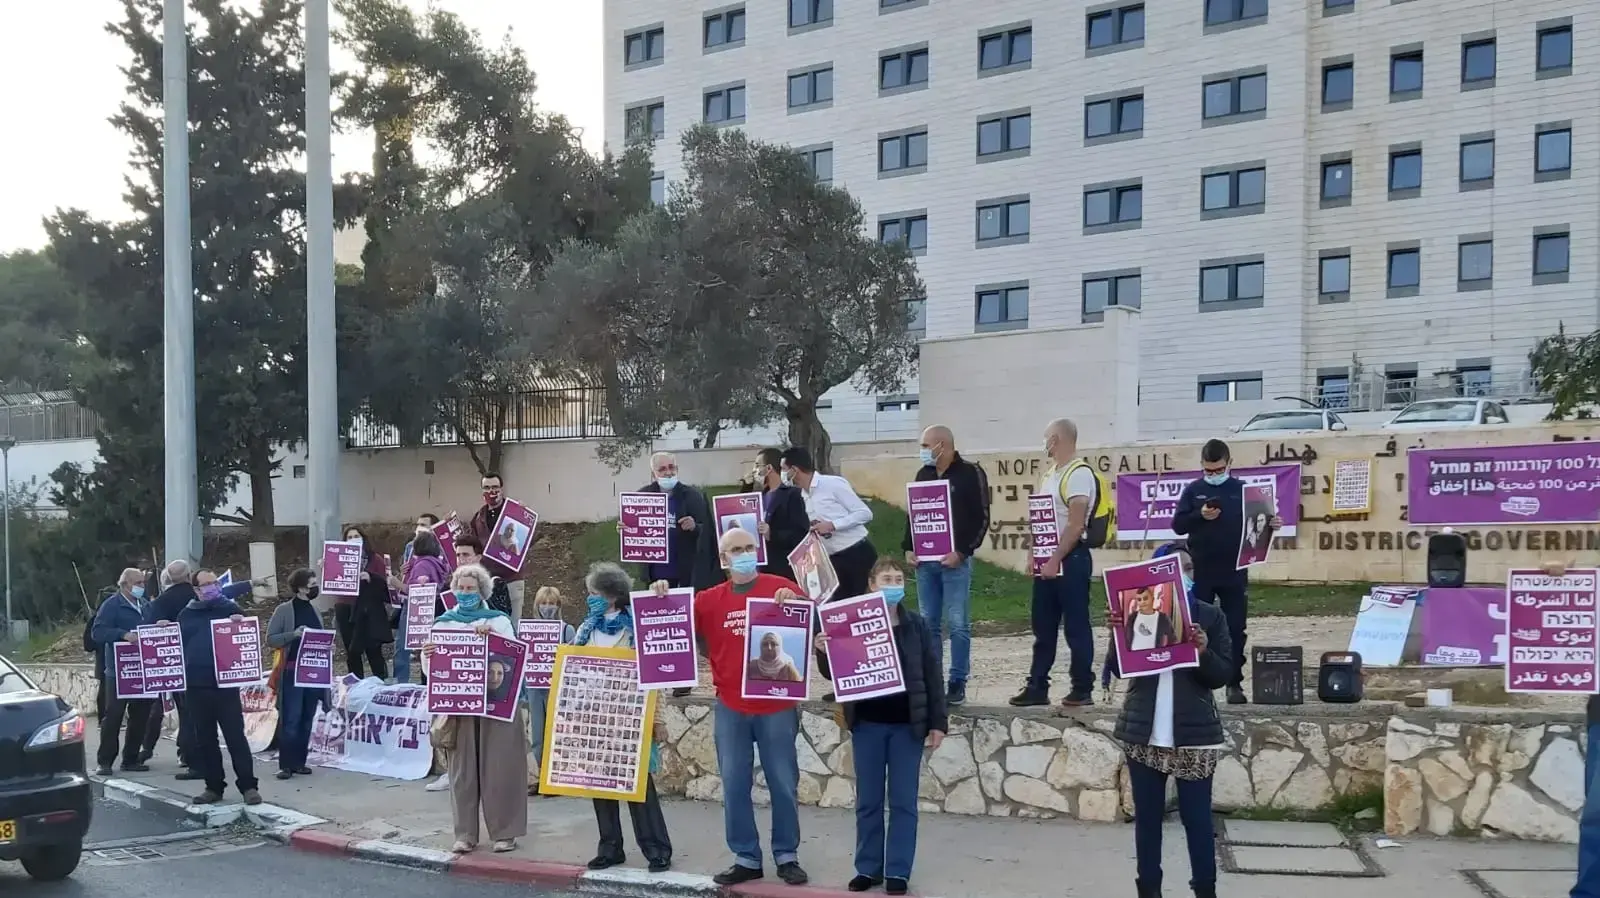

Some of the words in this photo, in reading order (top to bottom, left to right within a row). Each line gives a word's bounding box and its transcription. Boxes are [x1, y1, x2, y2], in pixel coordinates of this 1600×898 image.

[999, 458, 1040, 475] NOF
[1429, 461, 1471, 475] מחדל
[1473, 461, 1492, 473] זה
[1494, 459, 1553, 473] קורבנות
[1556, 458, 1584, 470] 100
[1429, 479, 1469, 496] إخفاق
[1471, 478, 1495, 491] هذا
[1497, 477, 1535, 492] ضحية
[1538, 479, 1563, 489] 100
[1565, 480, 1587, 491] من
[1032, 524, 1056, 532] רוצה
[1148, 561, 1176, 574] די
[1514, 577, 1593, 586] כשהמשטרה
[1515, 592, 1570, 608] الشرطة
[1573, 593, 1594, 606] لما
[784, 607, 808, 623] די
[1547, 614, 1594, 624] רוצה
[854, 619, 883, 633] ביחד
[645, 628, 669, 640] إخفاق
[671, 628, 687, 637] هذا
[1552, 630, 1592, 645] تنوي
[863, 633, 889, 645] ضد
[472, 646, 484, 655] لما
[645, 643, 673, 652] מחדל
[676, 642, 688, 650] זה
[870, 646, 889, 657] נגד
[1515, 648, 1558, 660] יכולה
[1564, 650, 1594, 660] היא
[454, 660, 484, 668] רוצה
[854, 656, 894, 673] العنف
[222, 670, 257, 679] האלימות
[842, 671, 895, 688] האלימות
[1513, 670, 1548, 685] تقدر
[1552, 670, 1593, 686] فهي
[433, 684, 461, 692] יכולה
[431, 698, 454, 709] تقدر
